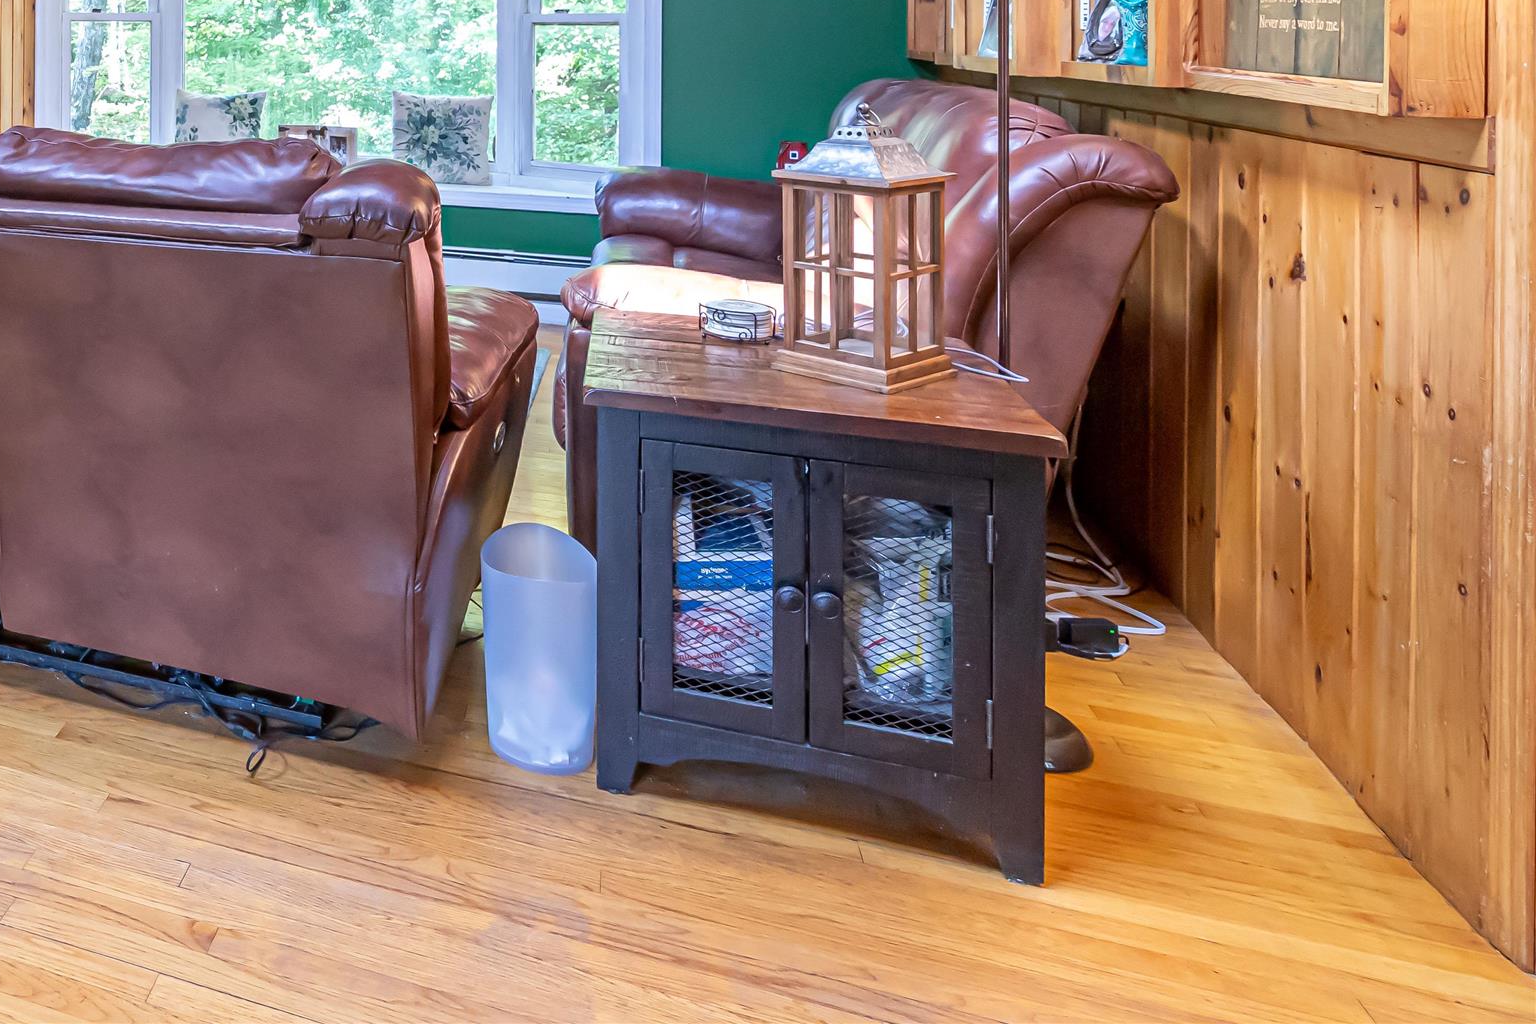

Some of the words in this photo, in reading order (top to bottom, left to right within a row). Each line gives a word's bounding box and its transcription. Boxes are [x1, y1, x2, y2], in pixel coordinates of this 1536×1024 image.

[1259, 14, 1278, 29] Never
[1279, 19, 1290, 33] say
[1297, 17, 1316, 30] word
[1316, 18, 1324, 30] to
